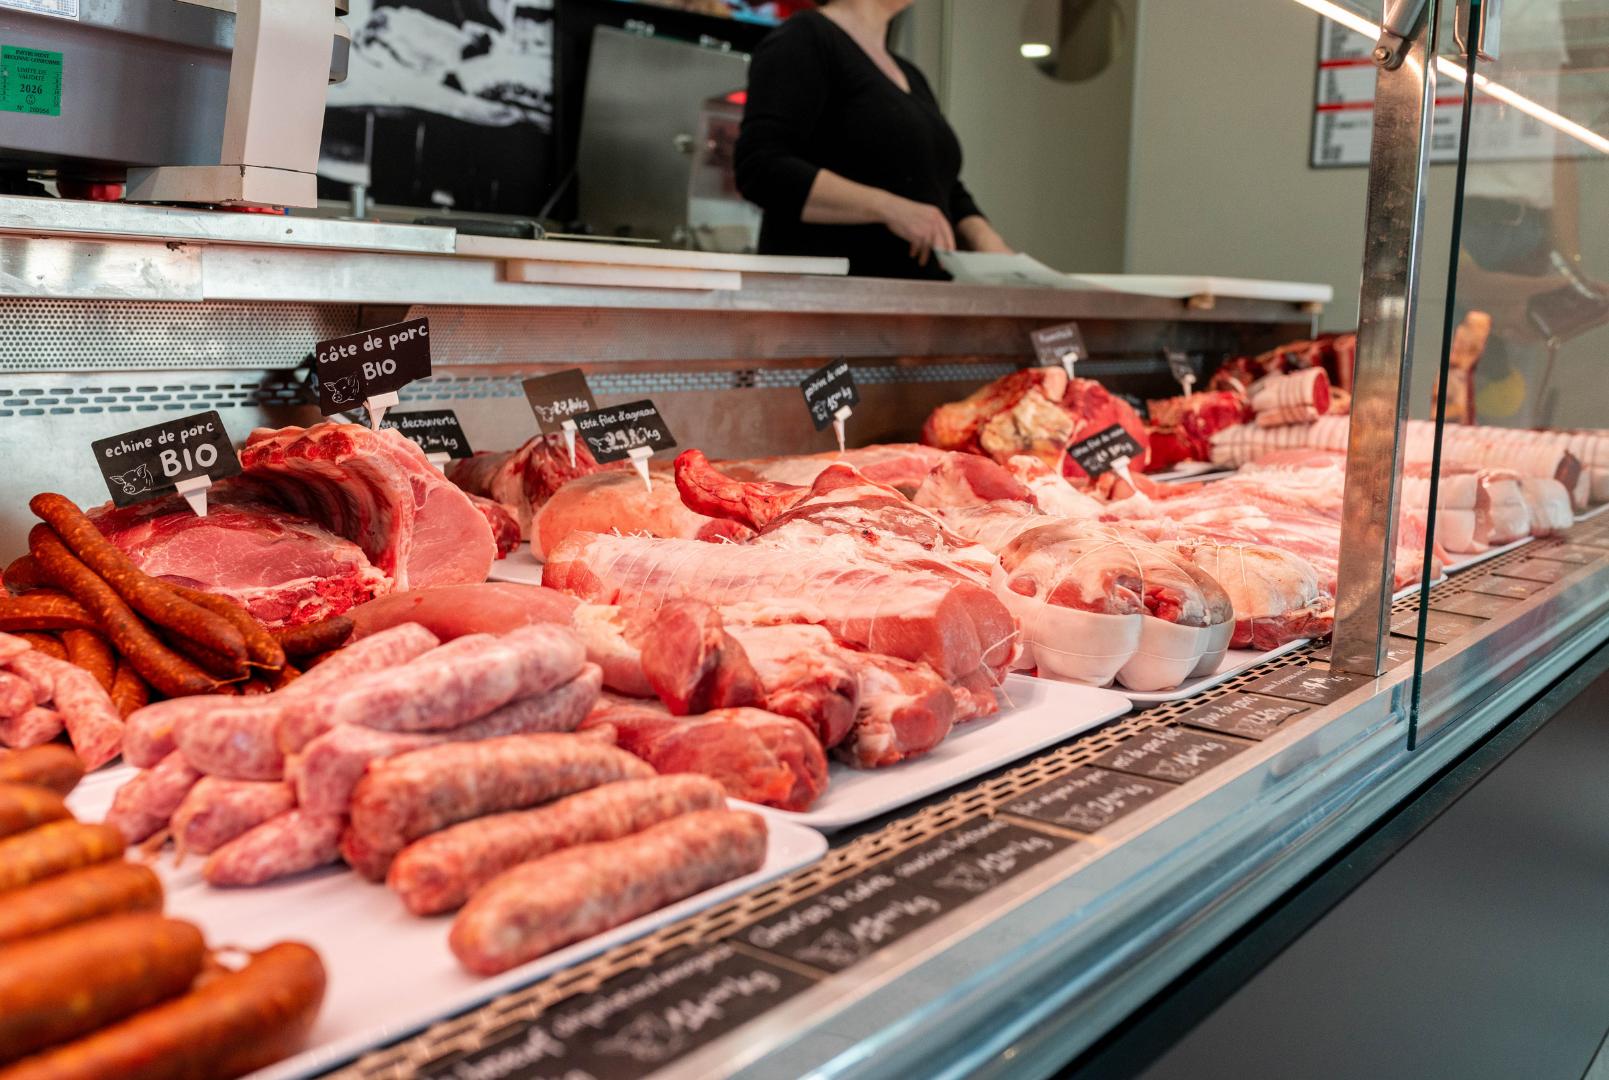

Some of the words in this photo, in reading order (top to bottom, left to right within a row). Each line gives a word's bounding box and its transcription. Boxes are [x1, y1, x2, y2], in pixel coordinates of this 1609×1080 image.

[20, 83, 43, 94] 2026
[319, 345, 357, 365] côte
[363, 335, 382, 352] de
[388, 324, 429, 351] porc
[362, 358, 397, 381] BIO
[599, 414, 617, 427] filet
[618, 408, 656, 422] d'agneau
[105, 437, 153, 459] echine
[158, 429, 175, 445] de
[180, 422, 215, 443] porc
[441, 435, 458, 449] kg
[644, 427, 661, 441] kg
[159, 443, 218, 479] BIO
